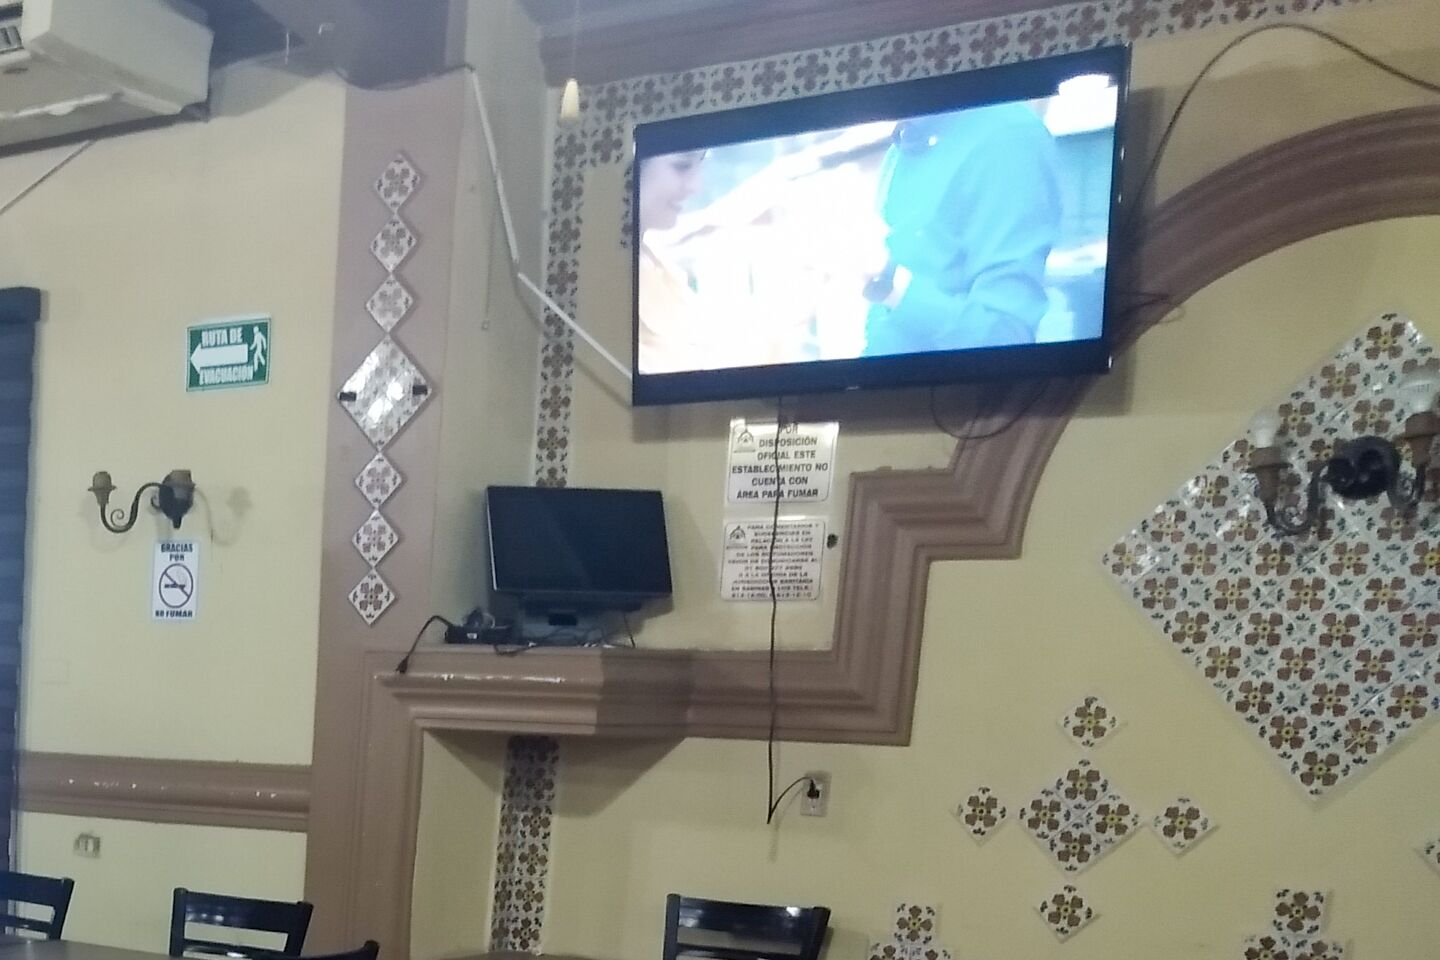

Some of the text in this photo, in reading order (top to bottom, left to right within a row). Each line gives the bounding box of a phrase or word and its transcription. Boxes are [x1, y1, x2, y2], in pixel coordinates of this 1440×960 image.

[201, 326, 243, 347] RUTA DE
[759, 436, 817, 447] DISOSICIÓN
[793, 450, 816, 459] ESTE
[732, 463, 829, 474] ESTABLECMIENTO NO
[788, 477, 809, 485] CON
[787, 489, 819, 498] FUMAR
[160, 543, 193, 553] GRACIAS
[169, 553, 185, 562] POR
[165, 609, 193, 618] FUMAR
